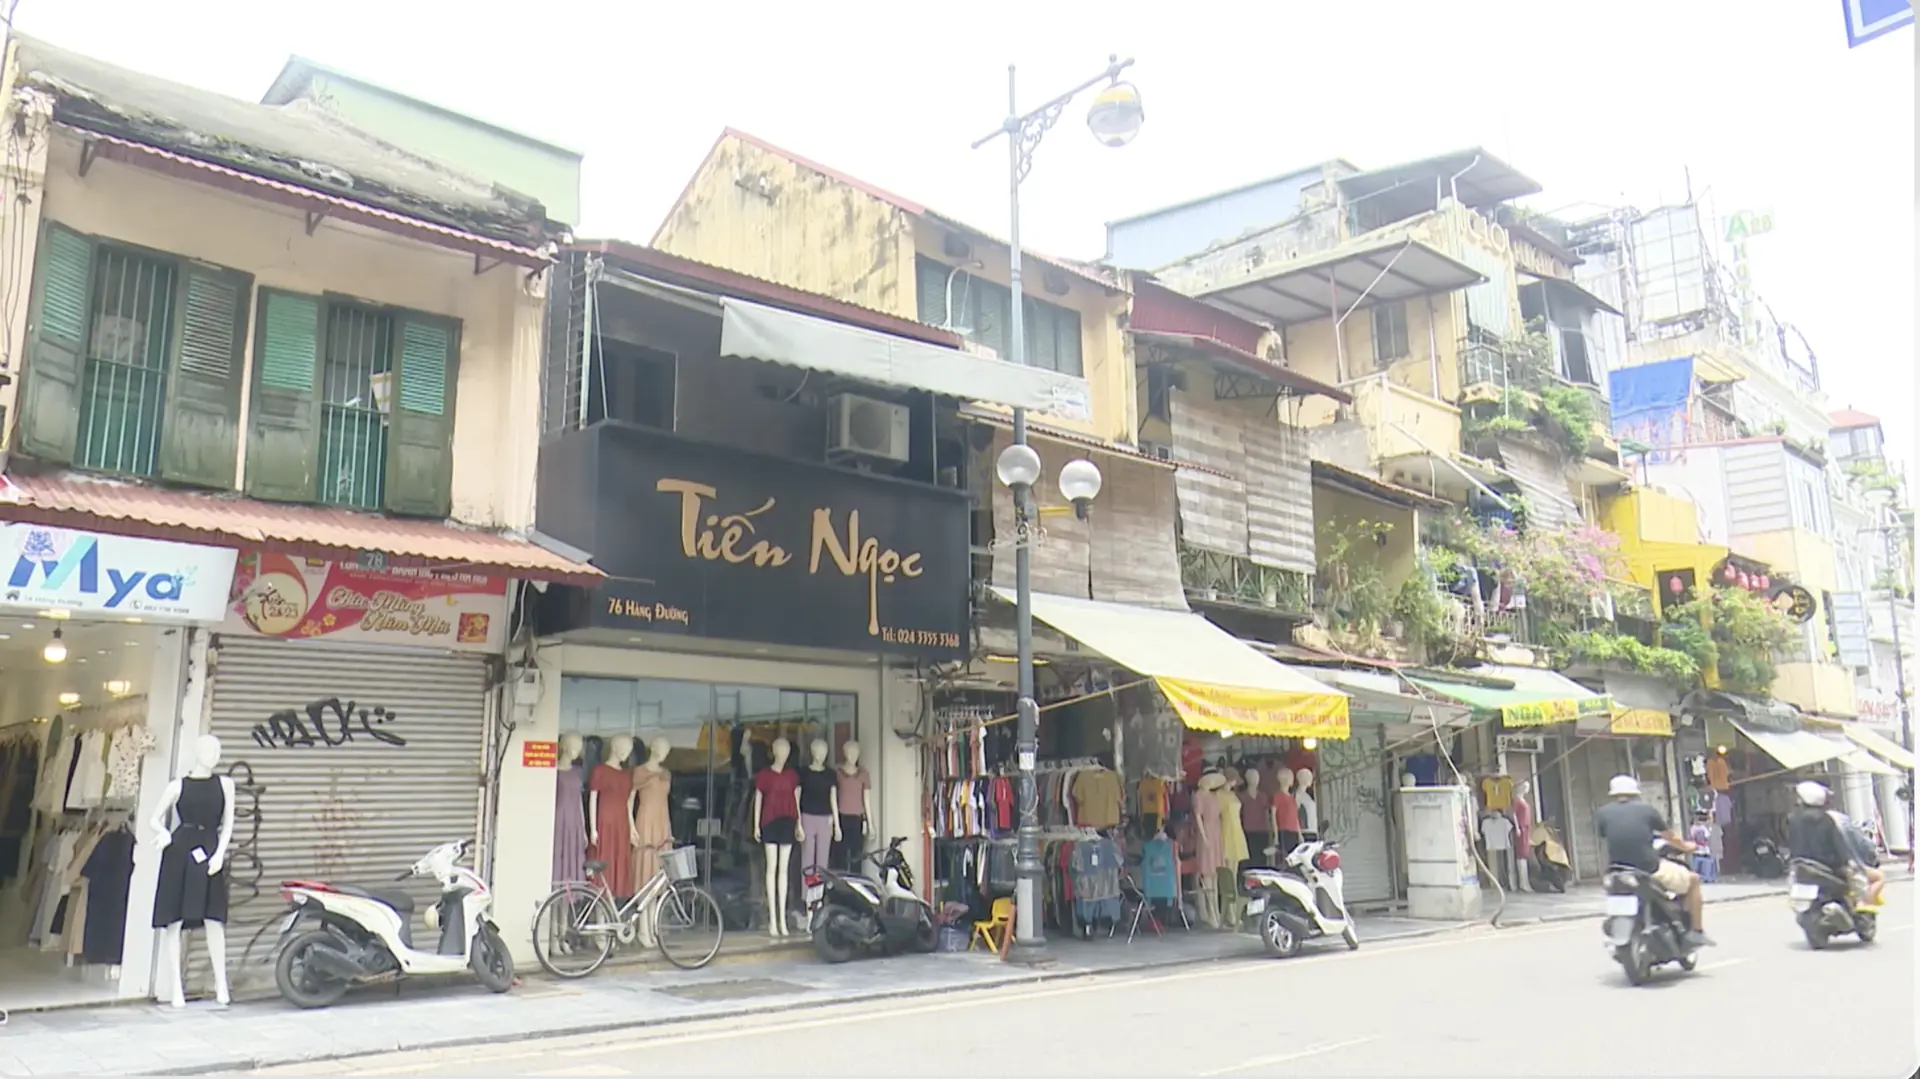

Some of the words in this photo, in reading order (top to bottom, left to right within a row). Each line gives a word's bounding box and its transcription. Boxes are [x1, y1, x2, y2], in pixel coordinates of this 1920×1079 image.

[365, 552, 384, 569] 78
[656, 478, 793, 568] Tiến
[809, 507, 923, 636] Ngọc
[8, 535, 183, 608] Mya
[608, 597, 623, 615] 76
[897, 628, 915, 644] 024
